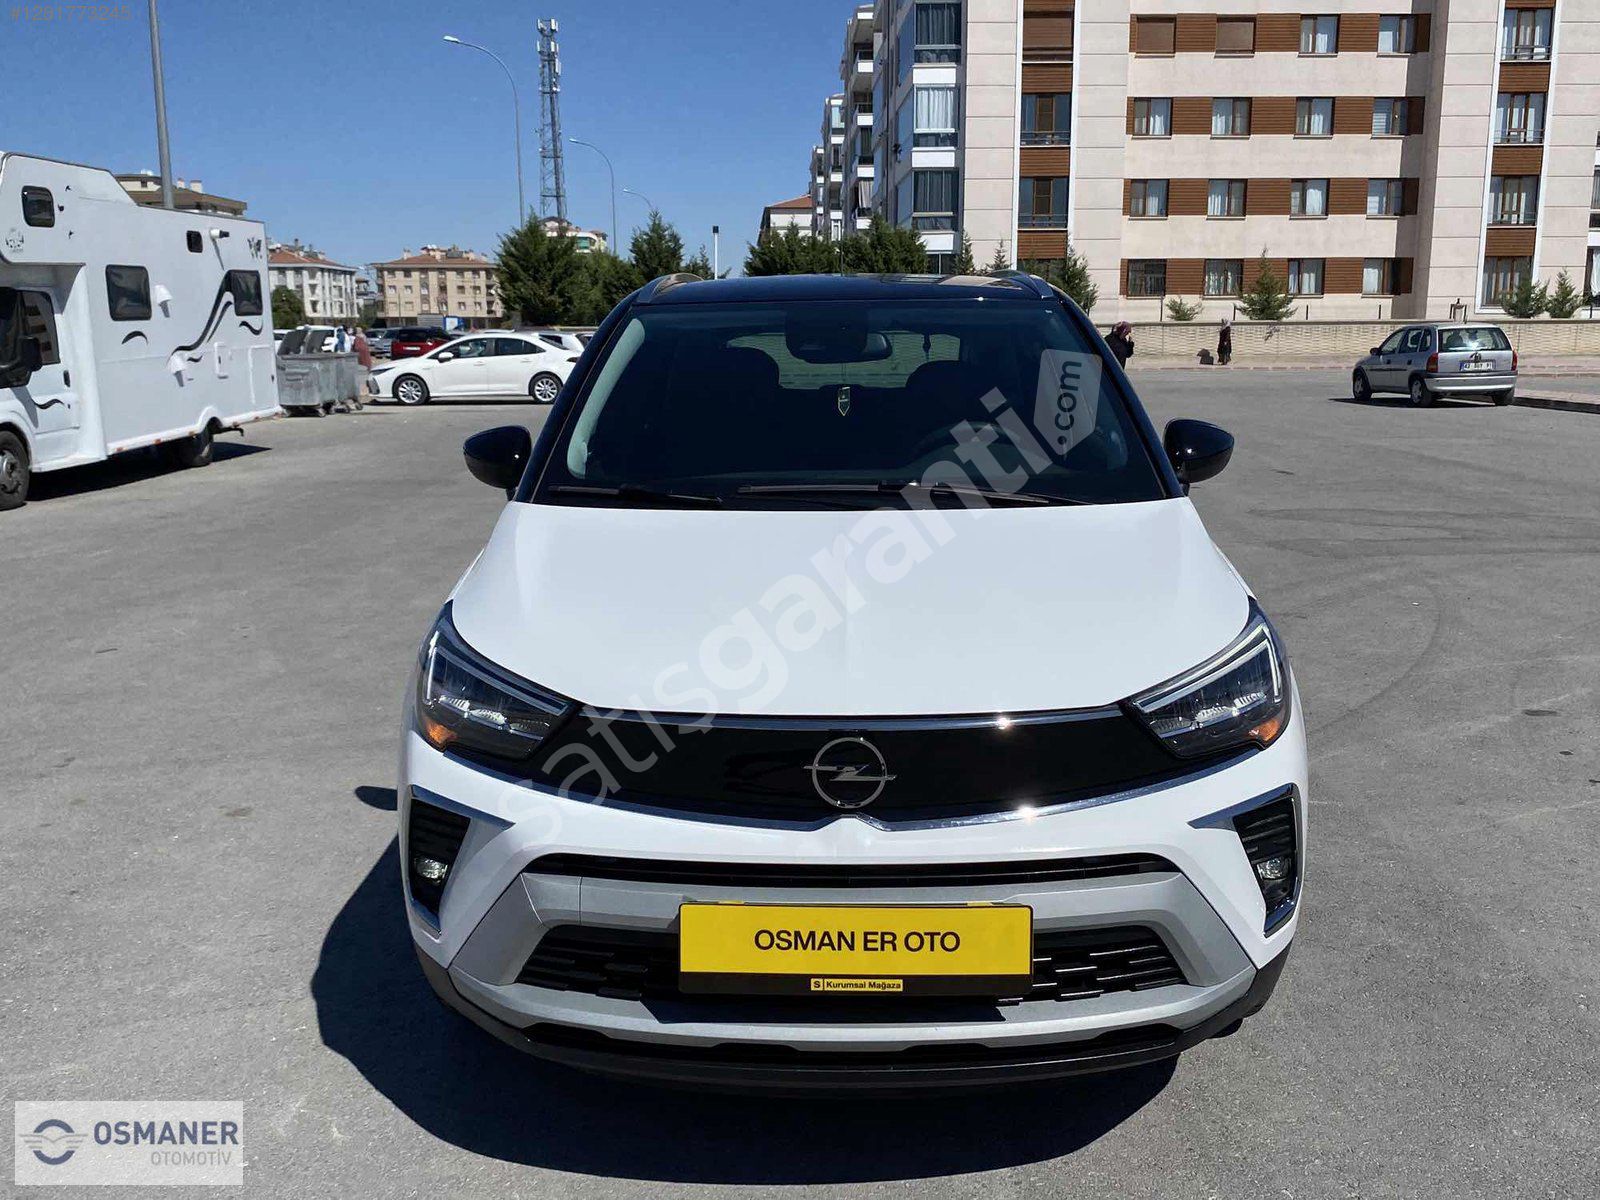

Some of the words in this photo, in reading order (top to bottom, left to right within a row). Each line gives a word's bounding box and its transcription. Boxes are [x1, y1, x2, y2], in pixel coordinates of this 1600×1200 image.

[754, 929, 855, 951] OSMAN
[863, 931, 897, 951] ER
[904, 931, 960, 952] OTO
[826, 980, 866, 989] Kurumsal
[868, 981, 901, 990] Mağaza
